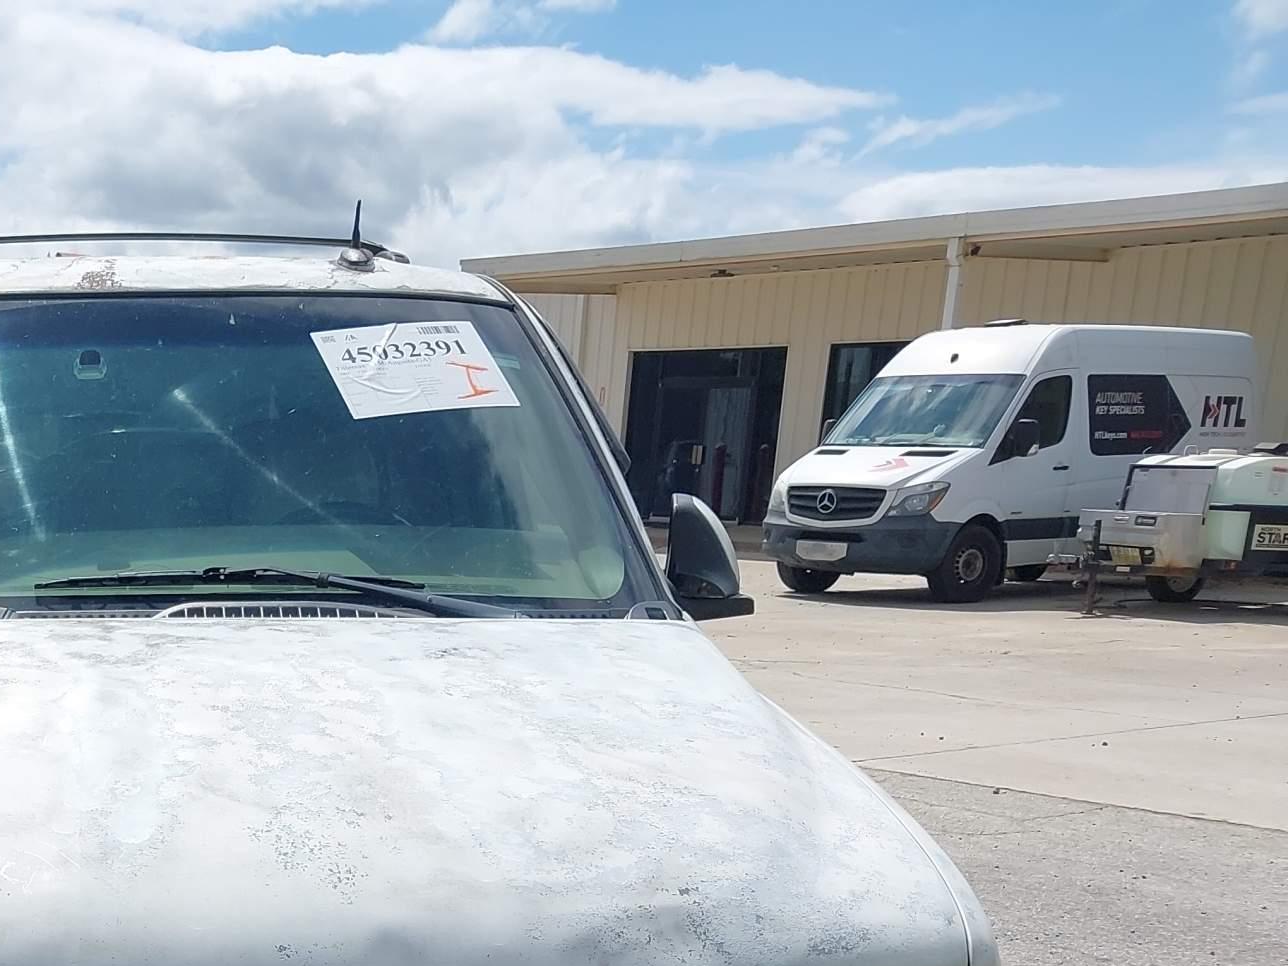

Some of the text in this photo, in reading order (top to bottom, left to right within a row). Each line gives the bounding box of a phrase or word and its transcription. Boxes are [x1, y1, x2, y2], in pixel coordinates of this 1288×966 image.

[341, 339, 467, 364] 45032391
[1096, 392, 1144, 404] AUTOMOTIVE
[1095, 405, 1145, 415] KEY SPECIALISTS
